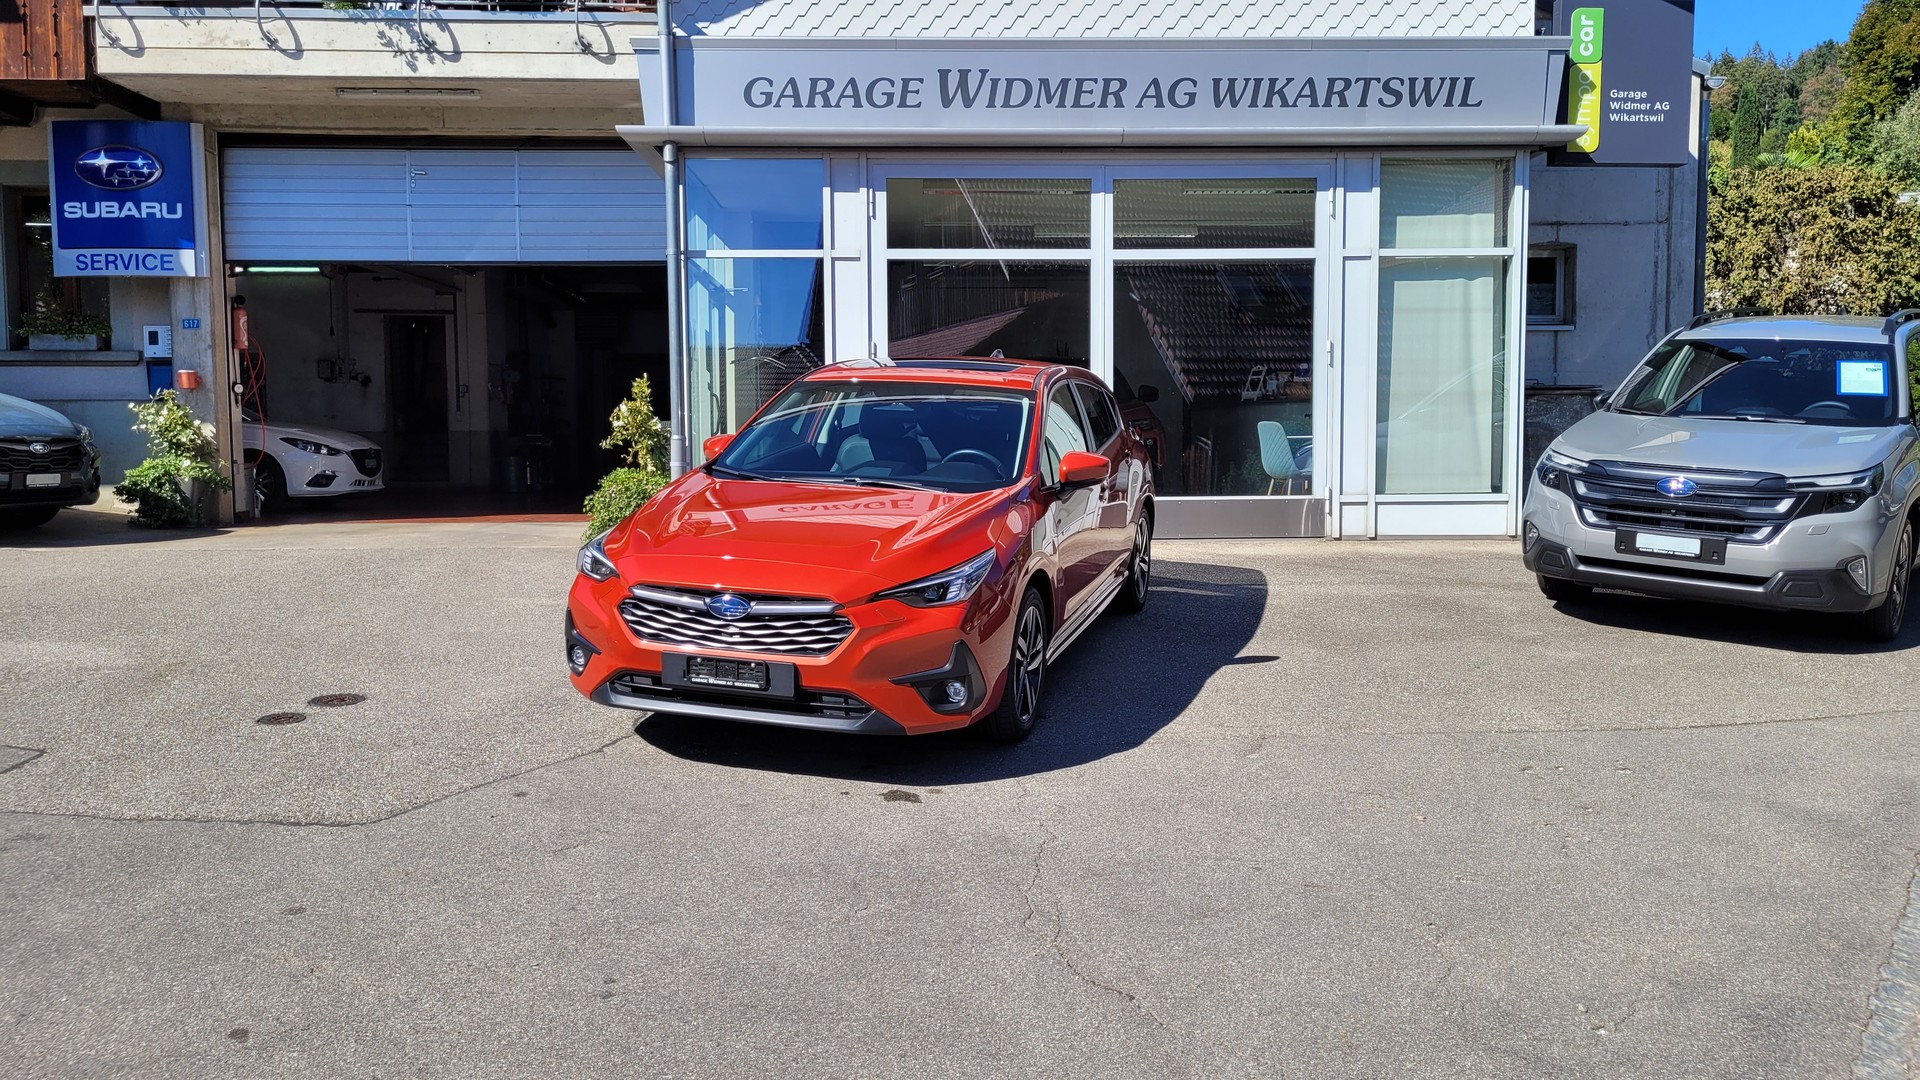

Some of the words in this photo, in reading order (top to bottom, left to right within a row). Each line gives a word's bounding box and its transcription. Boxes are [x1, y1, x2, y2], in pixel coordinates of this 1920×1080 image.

[1579, 14, 1595, 57] car
[743, 76, 924, 109] GARAGE
[937, 68, 1128, 109] WIDMER
[1134, 77, 1198, 109] AG
[1211, 76, 1483, 109] WIKARTSWIL
[1609, 89, 1648, 100] Garage
[1609, 101, 1651, 111] Widmer
[1654, 101, 1670, 111] AG
[1609, 113, 1664, 122] Wikartswil
[63, 201, 183, 219] SUBARU
[75, 253, 175, 272] SERVICE
[184, 320, 198, 328] 617
